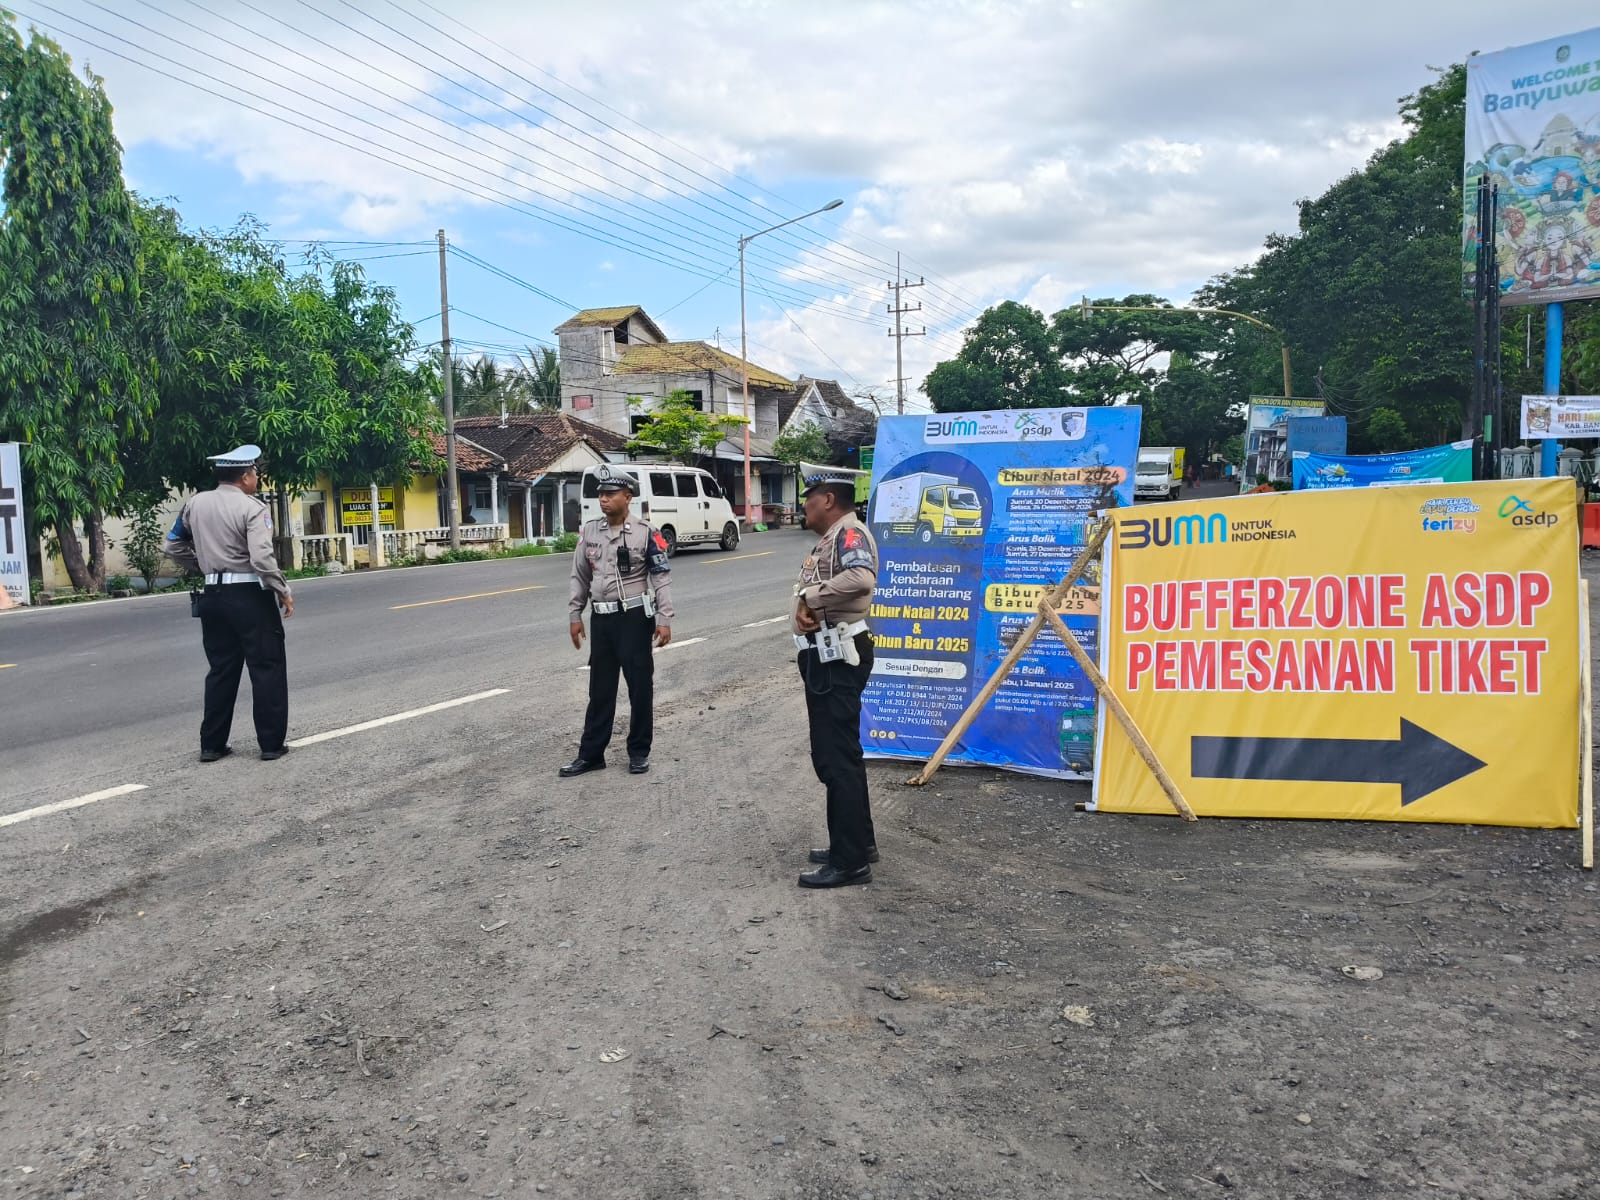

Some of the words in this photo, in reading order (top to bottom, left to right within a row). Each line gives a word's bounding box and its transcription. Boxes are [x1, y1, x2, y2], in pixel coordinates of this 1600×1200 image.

[1512, 62, 1590, 90] WELCOME
[1484, 76, 1600, 113] Banyuwa
[926, 420, 978, 437] BUMN
[1022, 424, 1053, 437] asdp
[1004, 469, 1041, 482] Libur
[1043, 470, 1081, 482] Natal
[1084, 469, 1120, 482] 2024
[1012, 488, 1033, 496] Arus
[350, 503, 366, 511] LUAS
[1120, 513, 1227, 550] BUMN
[1231, 519, 1272, 531] UNTUK
[1422, 517, 1476, 534] ferizy
[1512, 511, 1558, 528] asdp
[1231, 530, 1296, 542] INDONESIA
[1008, 535, 1030, 543] Arus
[1031, 534, 1056, 543] Balik
[0, 561, 22, 576] JAM
[886, 560, 961, 573] Pembatasan
[890, 573, 954, 586] kendaraan
[872, 586, 927, 599] angkutan
[929, 587, 973, 601] barang
[995, 587, 1040, 598] Libur
[995, 598, 1033, 608] Baru
[1122, 573, 1407, 634] BUFFERZONE
[1420, 571, 1551, 629] ASDP
[870, 603, 901, 618] Libur
[902, 605, 935, 620] Natal
[937, 606, 969, 621] 2024
[1001, 616, 1022, 624] Arus
[912, 622, 922, 635] &
[904, 635, 934, 650] Baru
[936, 637, 969, 652] 2025
[885, 662, 911, 671] Sesuai
[913, 664, 943, 674] Dengan
[1022, 665, 1046, 674] Balik
[1126, 637, 1396, 693] PEMESANAN
[1408, 637, 1549, 695] TIKET
[1001, 679, 1019, 687] abu,
[1024, 680, 1053, 688] Januari
